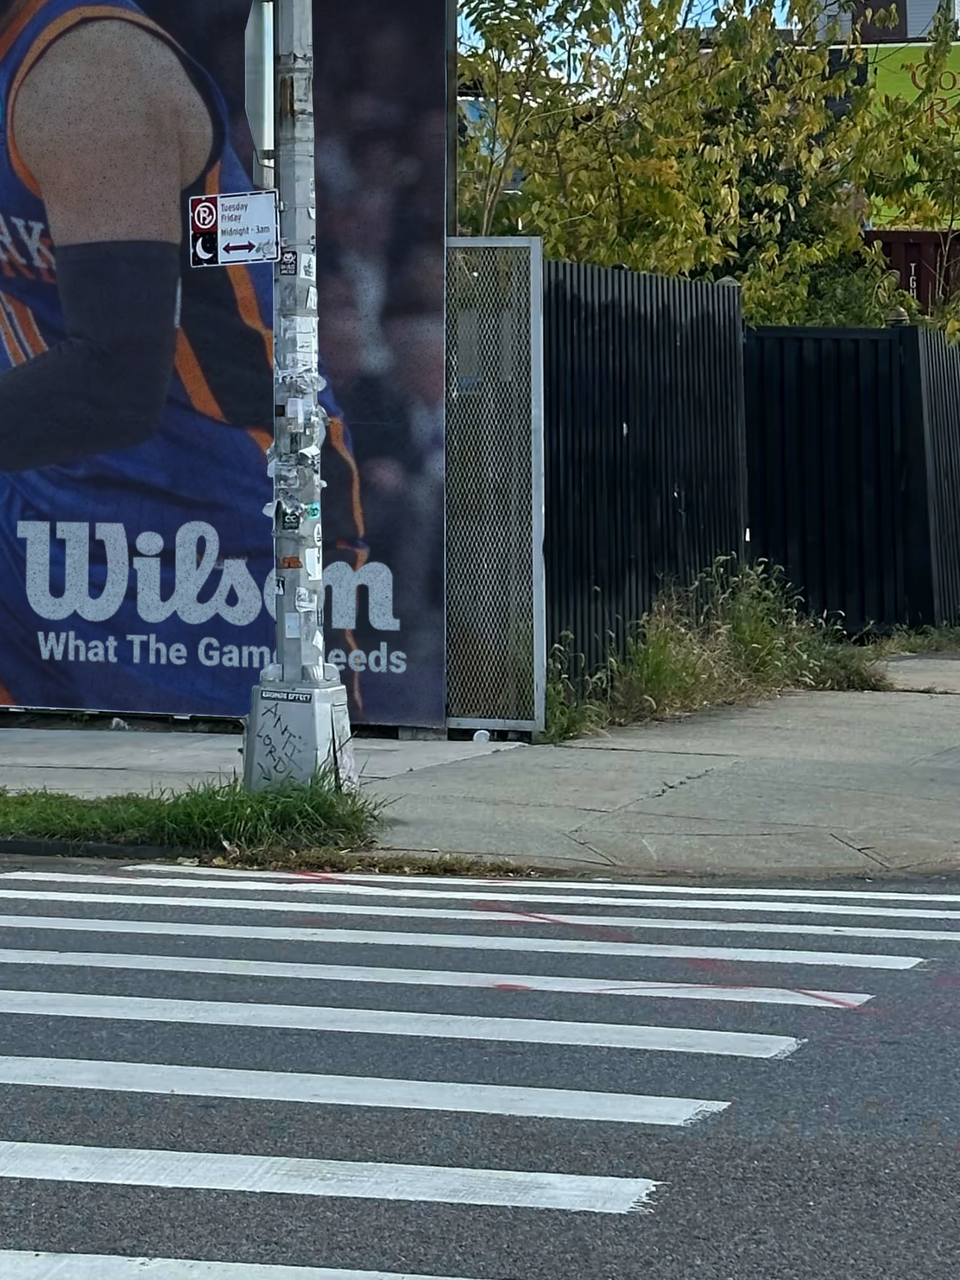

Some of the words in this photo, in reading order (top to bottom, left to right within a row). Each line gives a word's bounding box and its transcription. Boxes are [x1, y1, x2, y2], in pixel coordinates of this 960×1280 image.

[220, 203, 248, 213] Tuesday
[220, 213, 242, 223] Friday
[220, 226, 250, 237] Midnight
[256, 224, 270, 234] 3am
[16, 520, 400, 631] Wilsn
[37, 631, 118, 663] What
[125, 633, 188, 666] The
[197, 636, 277, 668] Gam
[326, 641, 408, 674] eeds
